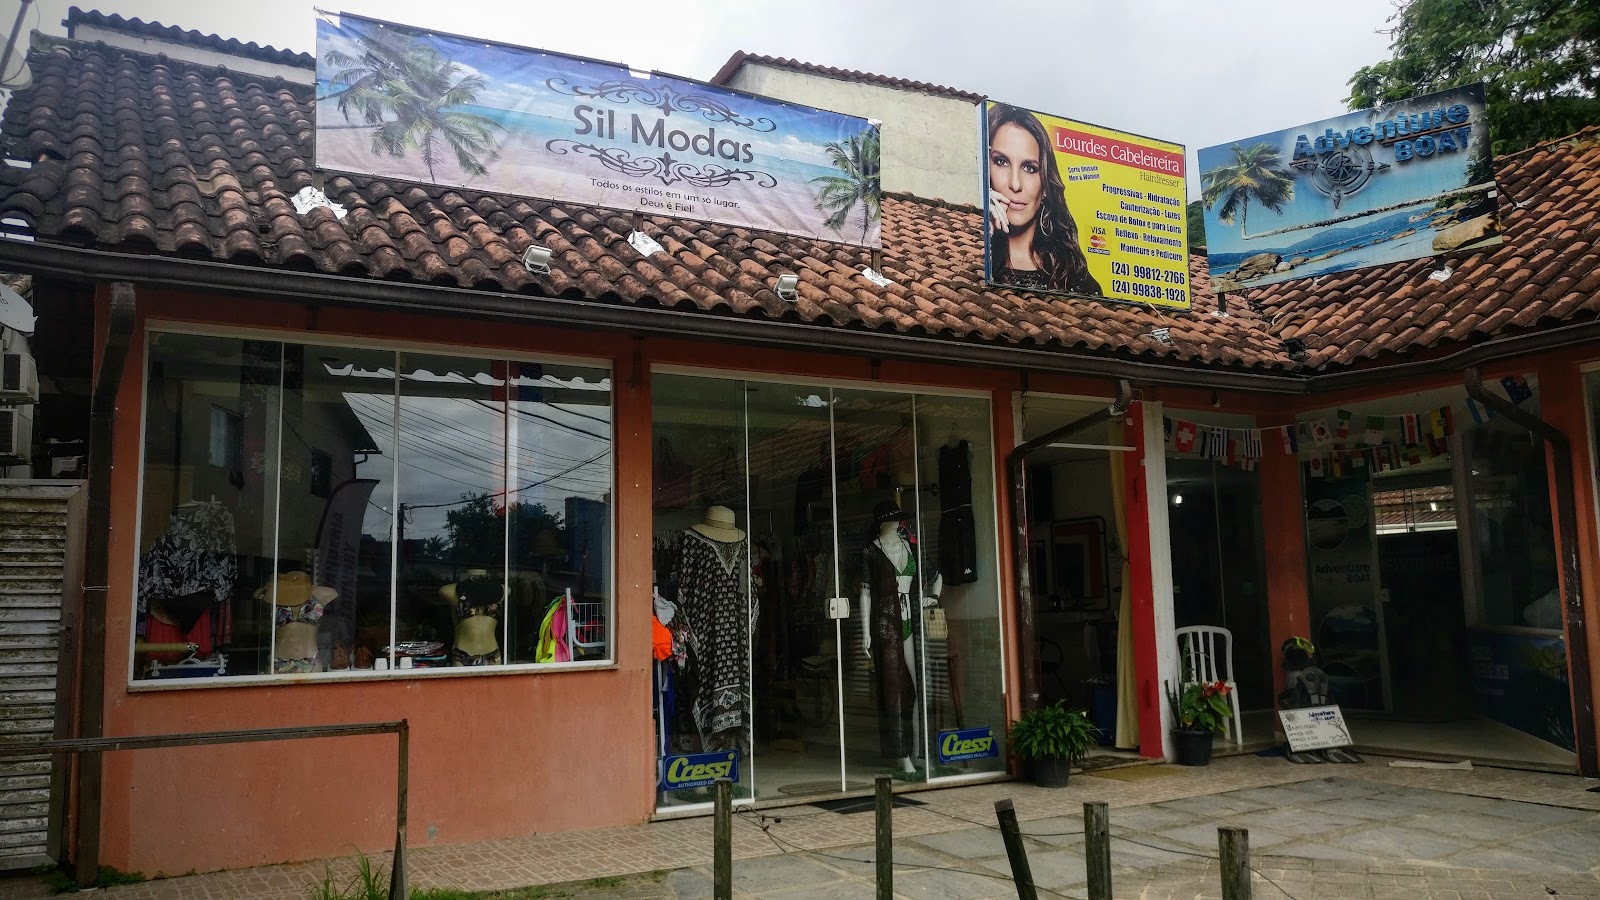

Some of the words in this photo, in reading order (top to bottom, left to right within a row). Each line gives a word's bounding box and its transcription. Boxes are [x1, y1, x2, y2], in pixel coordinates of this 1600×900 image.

[574, 105, 615, 140] Sil
[631, 114, 753, 163] Modas
[1292, 104, 1471, 160] Adventure
[1394, 126, 1472, 162] BOAT
[1056, 132, 1107, 156] Lourdes
[1111, 145, 1179, 172] Cabeleireira
[1140, 171, 1179, 187] Hairdresser
[590, 178, 620, 189] Todos
[635, 186, 663, 196] estilos
[665, 191, 681, 199] em
[713, 197, 740, 208] lugar.
[640, 197, 664, 208] Deus
[666, 201, 673, 209] é
[675, 202, 695, 212] Fiel!
[1102, 183, 1143, 199] Progressivas
[1147, 192, 1180, 207] Hidratação
[1096, 210, 1119, 222] Escova
[1120, 215, 1128, 224] de
[1128, 217, 1146, 227] Botox
[1152, 222, 1166, 231] para
[1166, 223, 1182, 234] Loira
[1120, 200, 1160, 216] Cauterização
[1164, 209, 1181, 220] Luzes
[1091, 226, 1106, 235] VISA
[1115, 228, 1139, 240] Reflexo
[1143, 232, 1182, 248] Relaxamento
[1120, 242, 1150, 256] Manicure
[1156, 249, 1183, 261] Pedicure
[1111, 261, 1130, 276] (24)
[1133, 264, 1185, 285] 99812-2766
[1112, 279, 1130, 294] (24)
[1132, 282, 1186, 303] 99838-1928
[941, 729, 993, 756] Cressi
[667, 752, 735, 783] Cressi
[677, 780, 707, 788] AUTHORIZED
